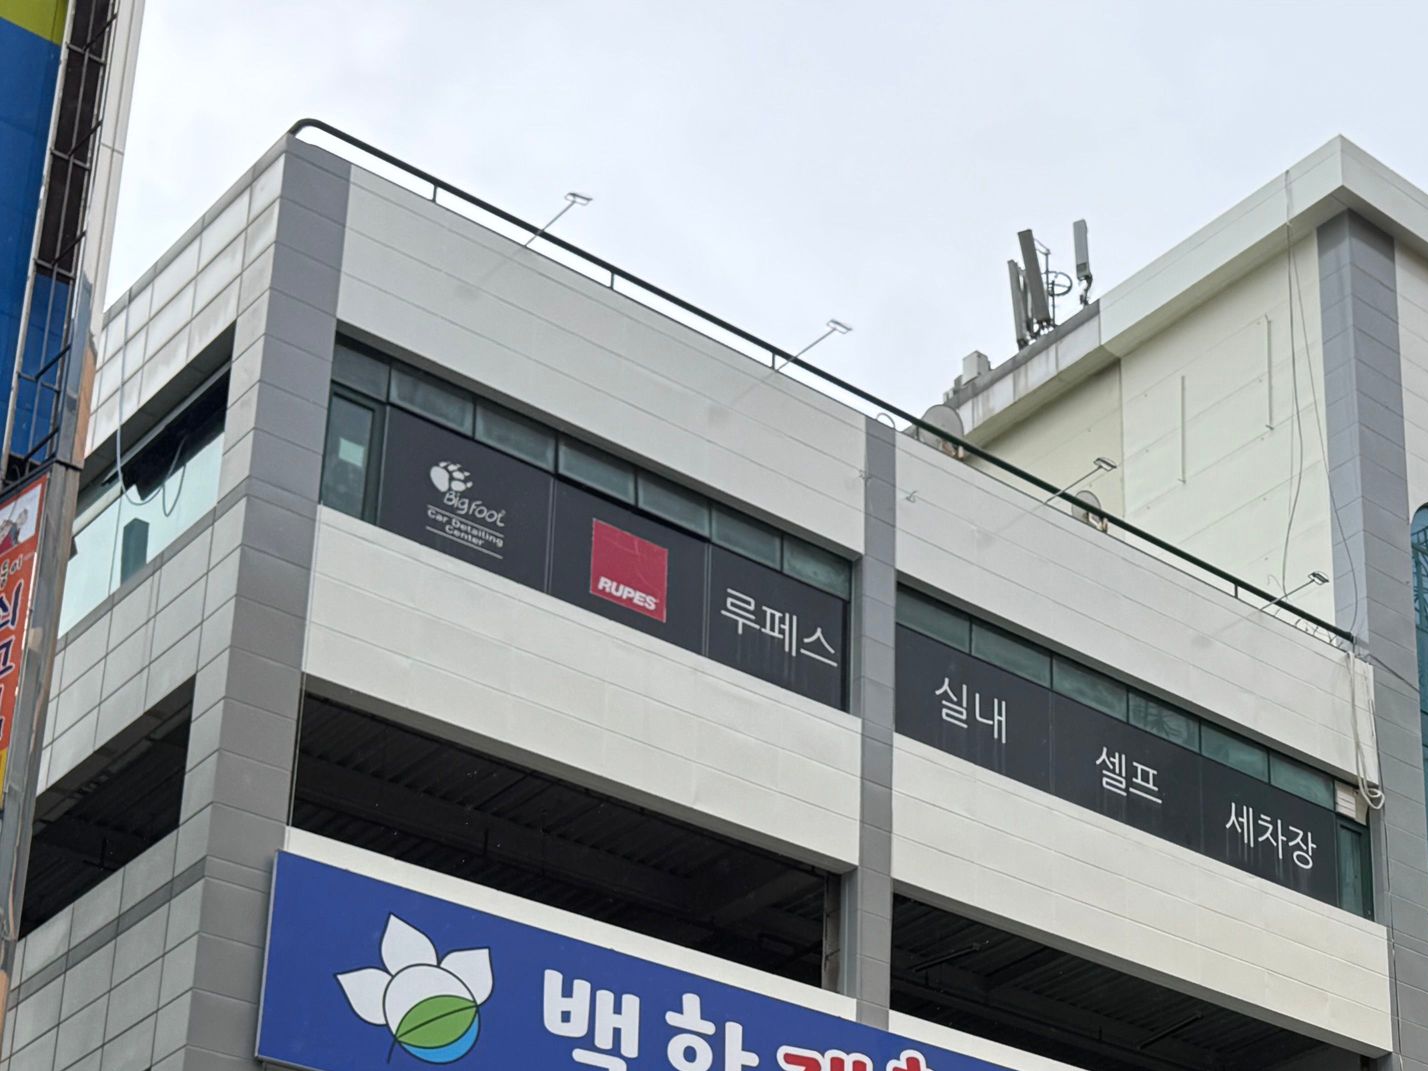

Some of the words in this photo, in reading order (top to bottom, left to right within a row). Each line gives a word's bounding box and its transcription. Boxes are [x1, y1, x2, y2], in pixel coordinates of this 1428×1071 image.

[427, 508, 449, 523] Car
[451, 515, 504, 547] Detailing
[445, 526, 485, 547] Center
[597, 576, 657, 611] RUPES
[721, 587, 838, 668] 루페스
[935, 677, 1007, 744] 실내
[1096, 745, 1162, 804] 셀프
[1226, 801, 1317, 870] 세차장
